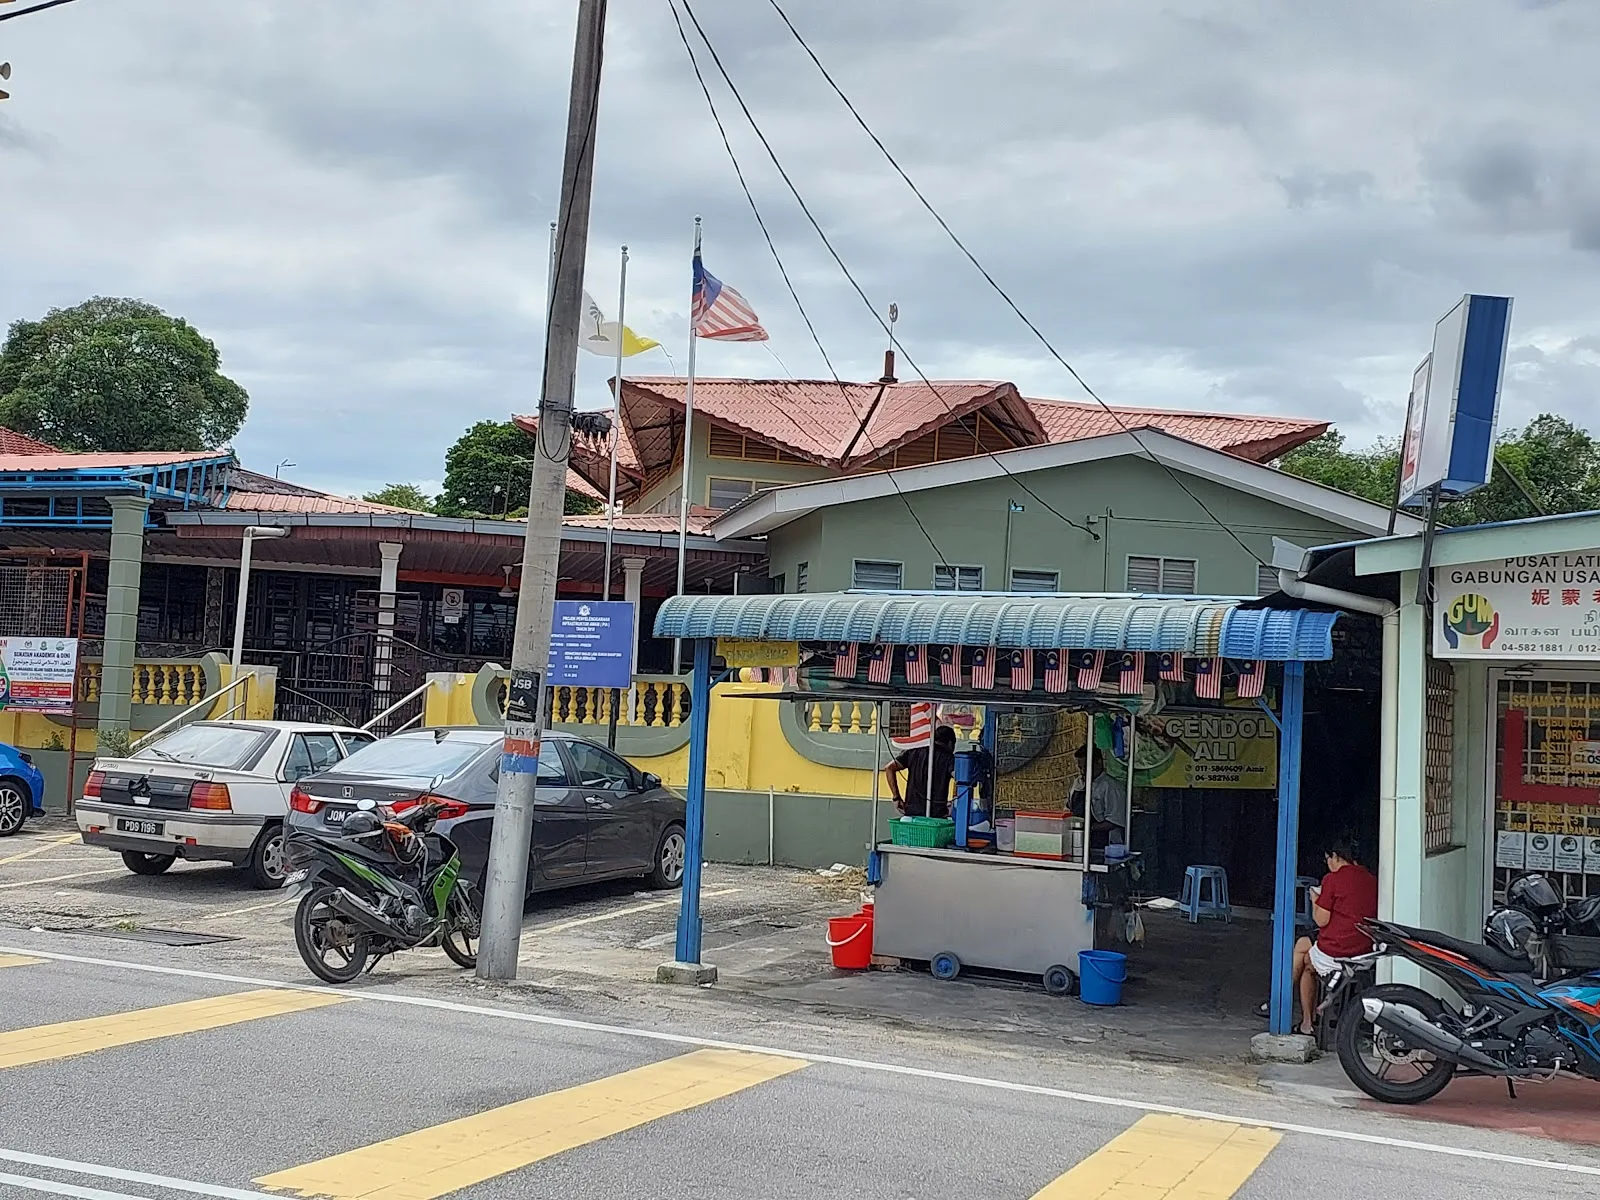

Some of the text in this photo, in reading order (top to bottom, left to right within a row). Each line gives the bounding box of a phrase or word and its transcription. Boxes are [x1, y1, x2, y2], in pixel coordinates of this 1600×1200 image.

[1504, 555, 1600, 568] PUSAT LATI
[1450, 570, 1600, 584] GABUNGAN USA
[1501, 643, 1536, 651] 04-582
[1539, 643, 1563, 652] 1881
[512, 678, 533, 690] JSB
[1165, 719, 1275, 739] CENDOL
[1193, 741, 1237, 762] ALI
